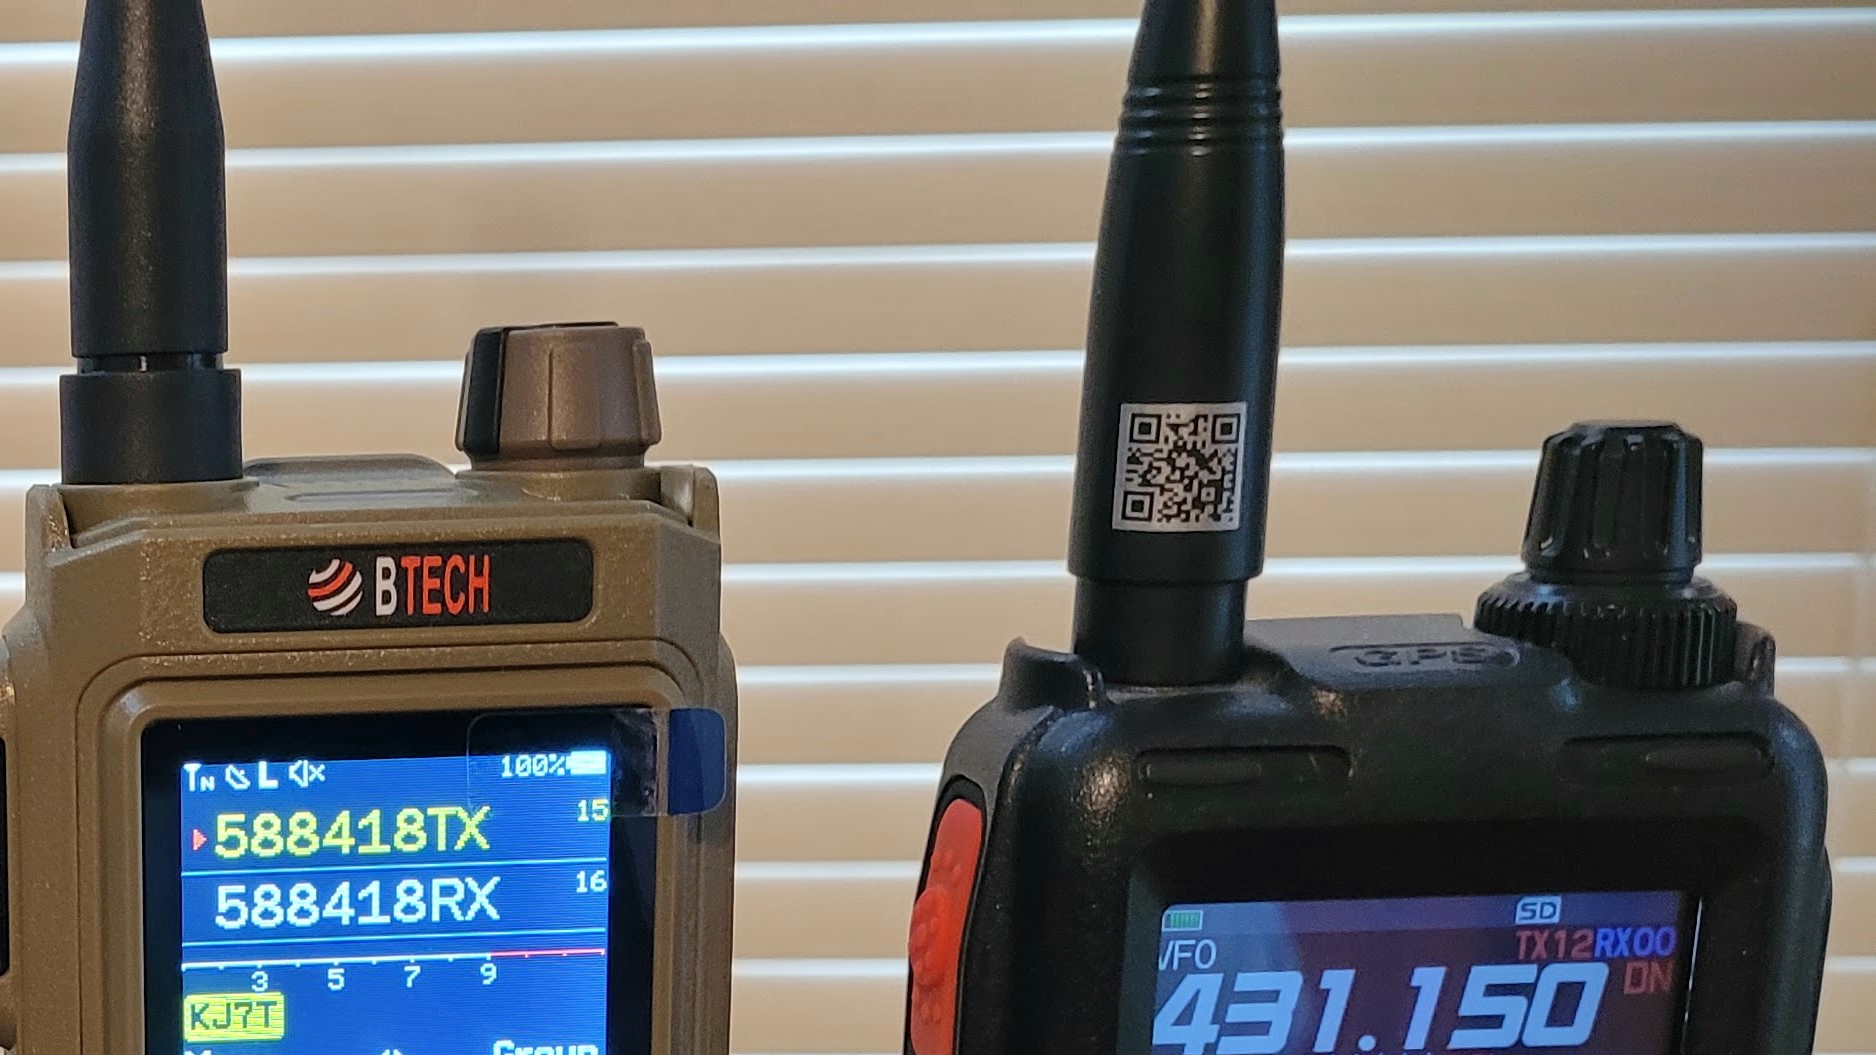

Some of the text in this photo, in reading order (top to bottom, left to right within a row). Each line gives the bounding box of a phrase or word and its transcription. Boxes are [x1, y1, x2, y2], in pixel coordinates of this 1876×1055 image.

[376, 555, 490, 616] BTECH
[257, 761, 279, 789] L
[500, 754, 565, 777] 100%
[576, 798, 610, 823] 15
[214, 804, 491, 859] 588418TX
[574, 870, 608, 894] 16
[214, 876, 502, 928] 588418RX
[1520, 900, 1558, 922] SD
[1158, 939, 1218, 971] VFO
[251, 963, 498, 992] 3 5 7 9
[1624, 961, 1673, 995] DN
[189, 1001, 277, 1032] KJ7T
